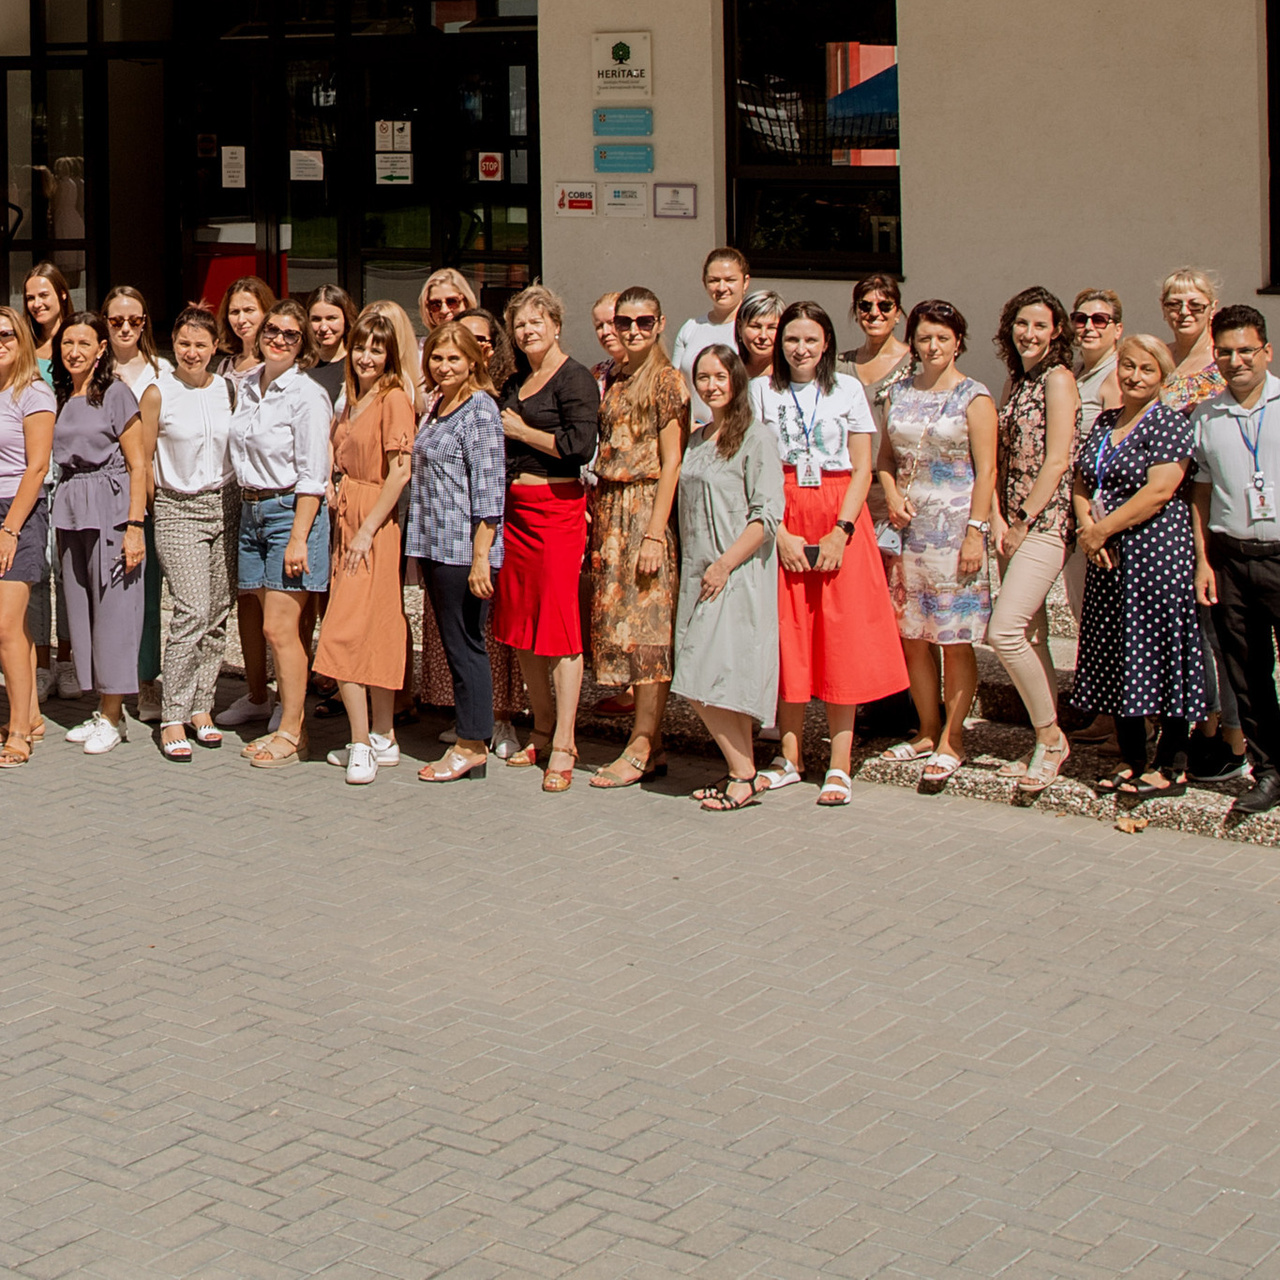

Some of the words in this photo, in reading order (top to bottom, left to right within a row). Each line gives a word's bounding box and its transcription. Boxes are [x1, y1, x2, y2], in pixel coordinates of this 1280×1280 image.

[597, 68, 646, 79] HERITAGE
[481, 162, 499, 171] STOP
[567, 191, 593, 199] COBIS
